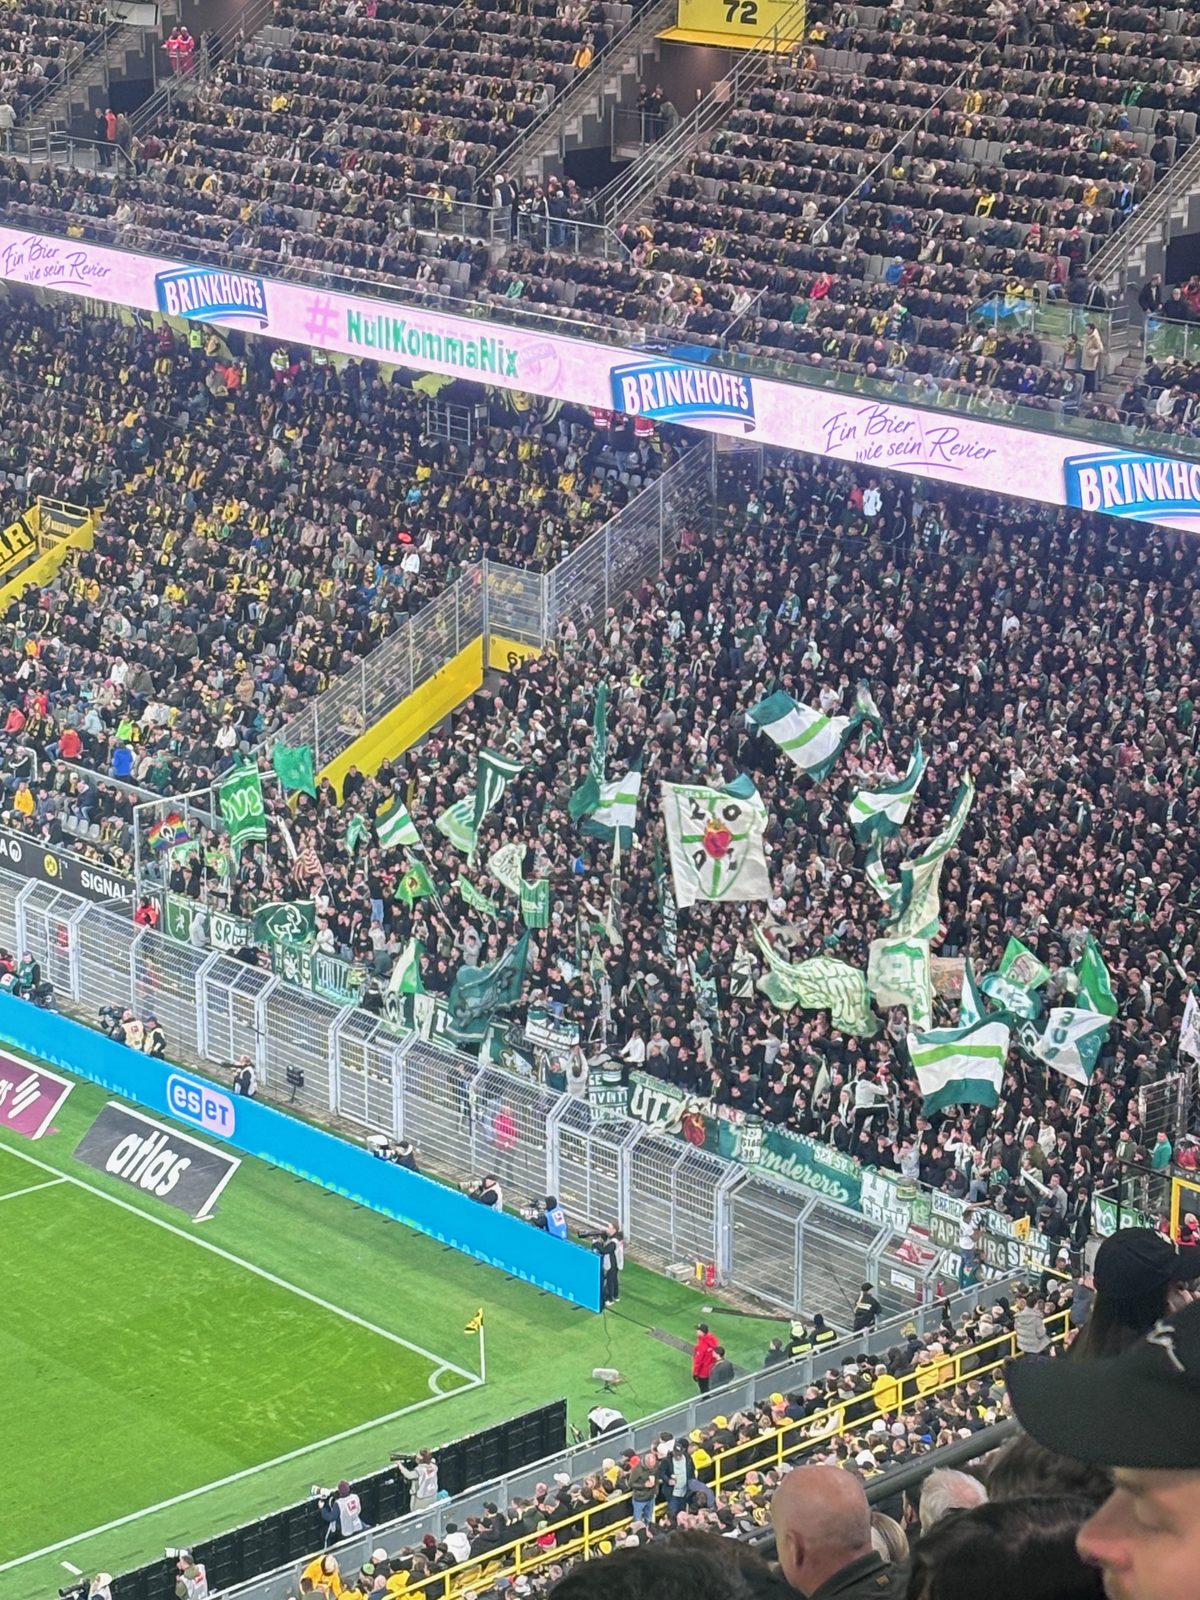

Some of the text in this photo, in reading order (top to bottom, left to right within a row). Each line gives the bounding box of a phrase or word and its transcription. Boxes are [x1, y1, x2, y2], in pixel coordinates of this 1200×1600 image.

[723, 0, 757, 24] 72
[1, 235, 61, 276] Ein Bier
[24, 251, 111, 280] wie sein Revier
[822, 404, 915, 454] Ein Bier
[855, 427, 997, 463] wie sein Revier
[80, 869, 130, 903] SIGNAL
[105, 1130, 192, 1197] atlas
